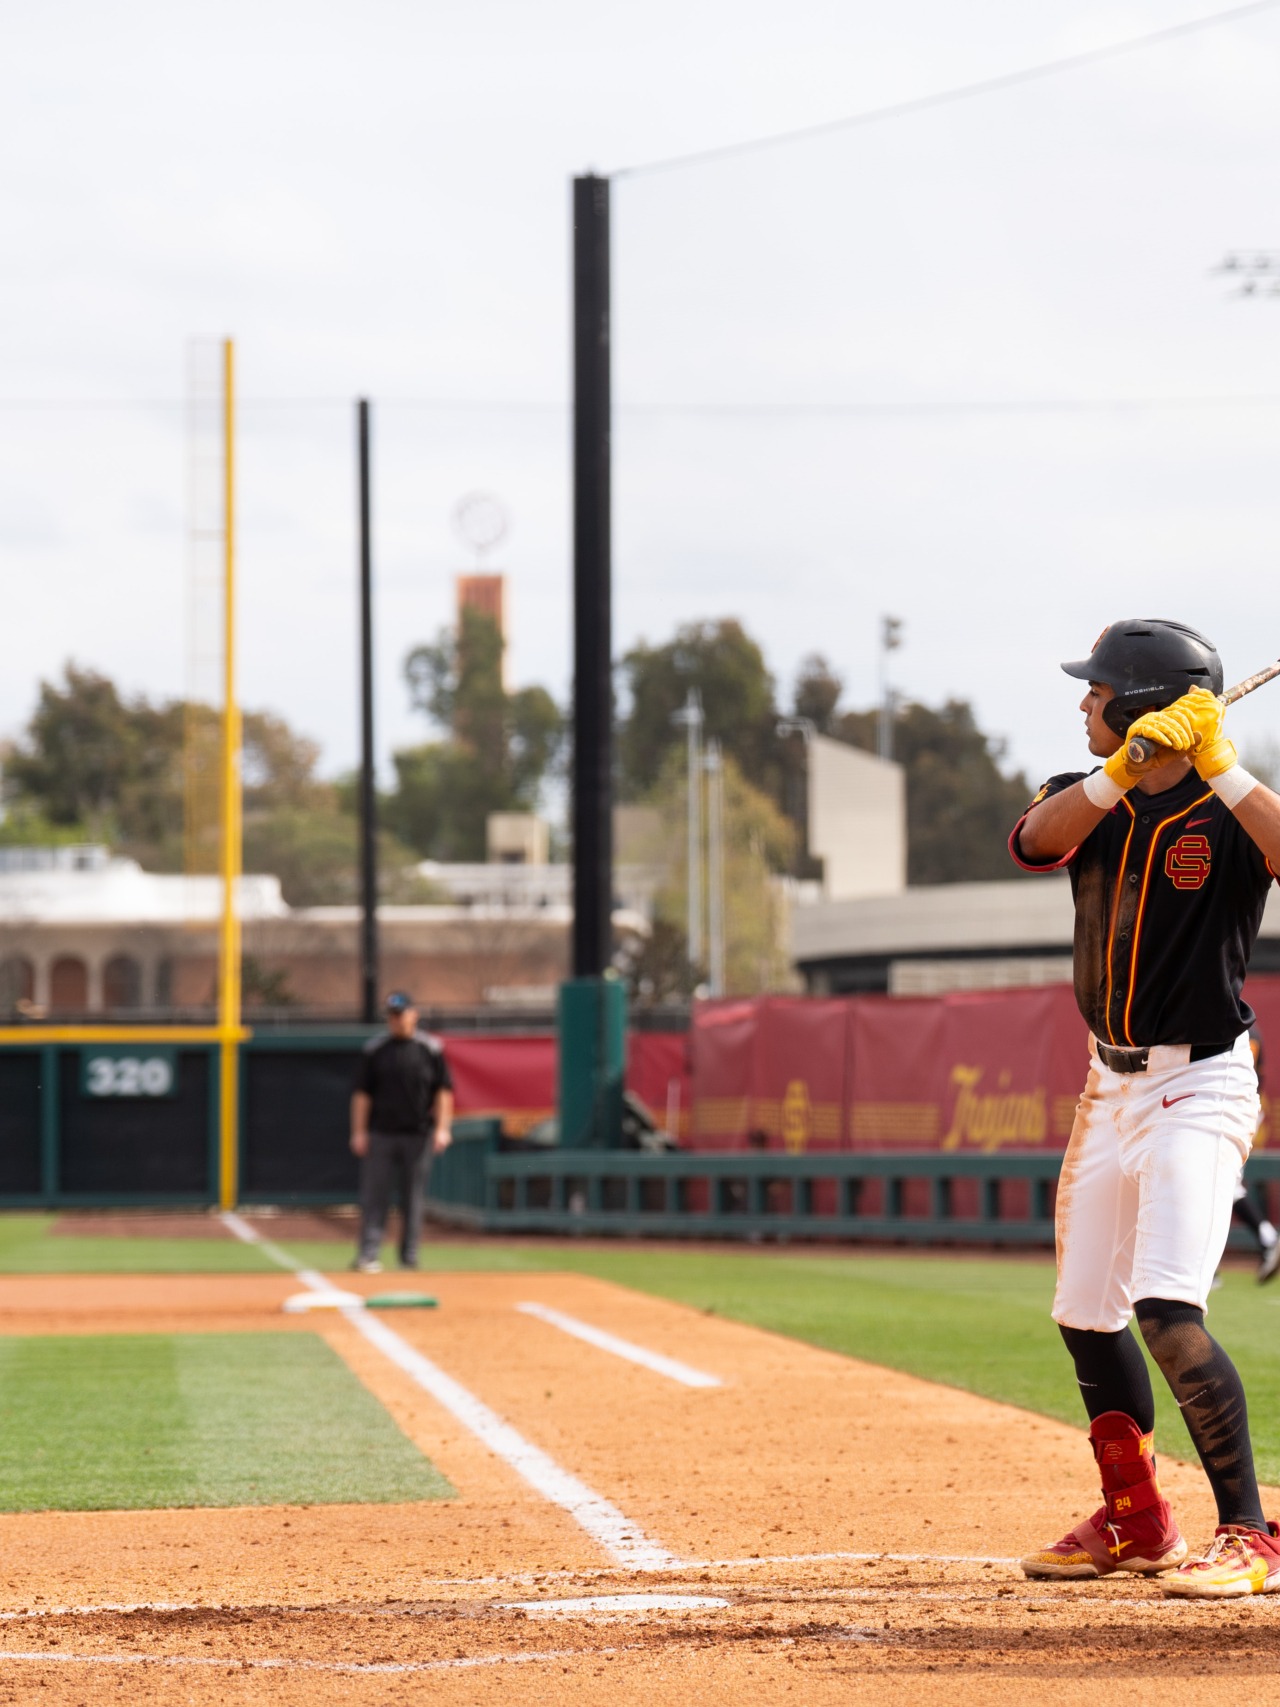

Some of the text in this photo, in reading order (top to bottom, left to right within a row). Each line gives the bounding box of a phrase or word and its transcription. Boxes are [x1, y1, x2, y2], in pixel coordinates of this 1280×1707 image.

[1124, 685, 1165, 696] EVOSHIELD
[86, 1056, 173, 1096] 320
[942, 1062, 1046, 1155] Trojans
[1115, 1496, 1132, 1511] 24
